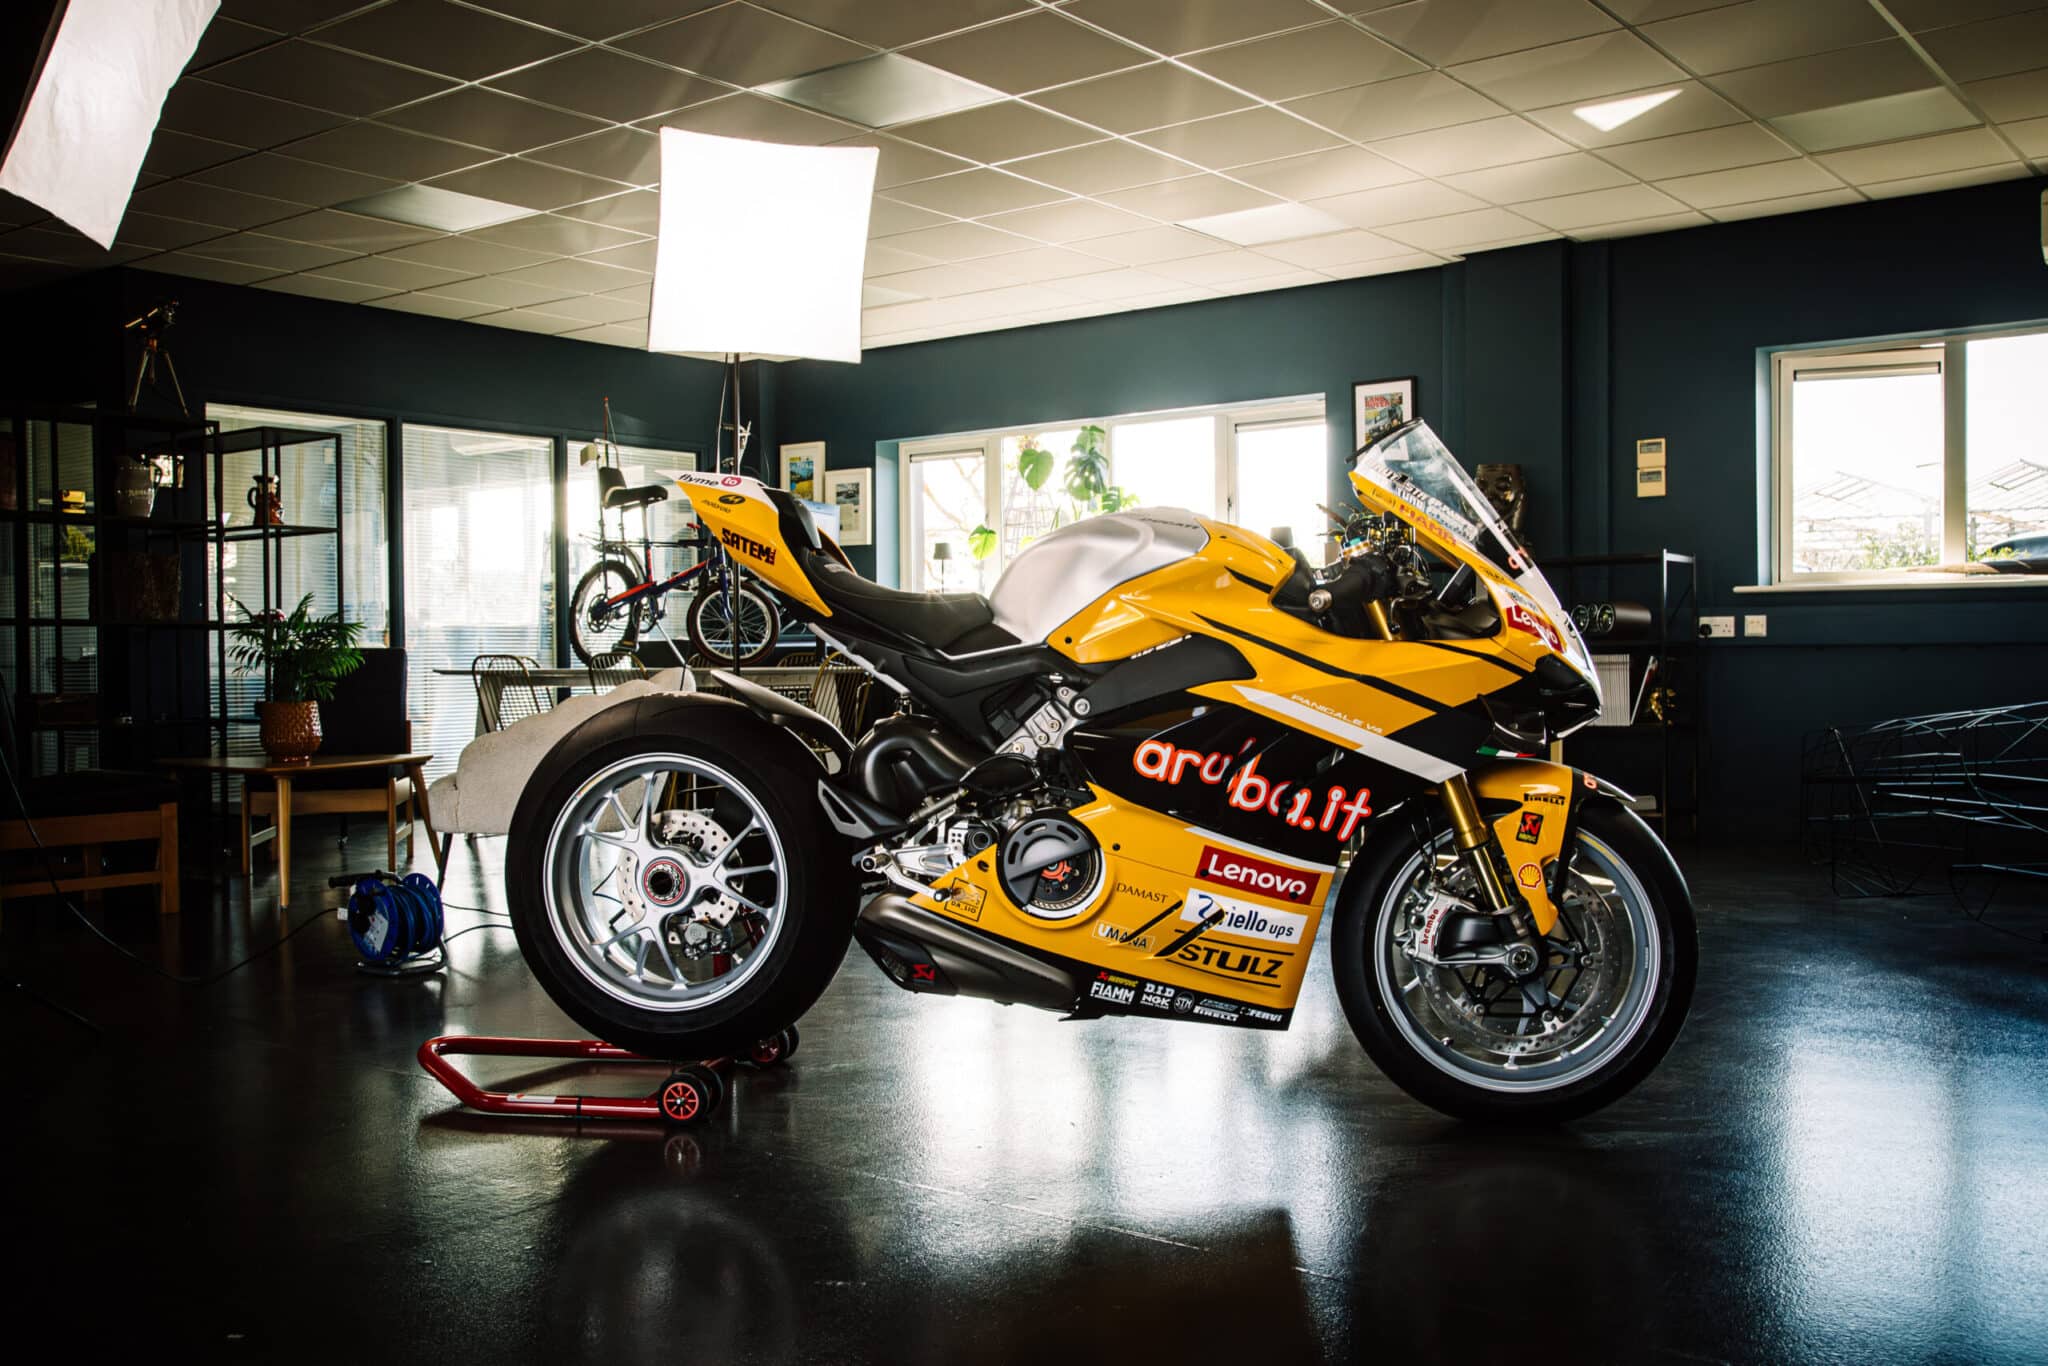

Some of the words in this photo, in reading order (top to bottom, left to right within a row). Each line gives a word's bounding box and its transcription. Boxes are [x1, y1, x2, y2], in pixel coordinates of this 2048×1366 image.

[1207, 853, 1308, 898] Lenovo
[1116, 882, 1169, 904] DAMAST
[1269, 924, 1294, 939] ups
[1420, 909, 1440, 944] brembo
[1178, 944, 1284, 979] STULZ
[1090, 981, 1135, 1003] FIAMM
[1141, 994, 1171, 1007] NGK
